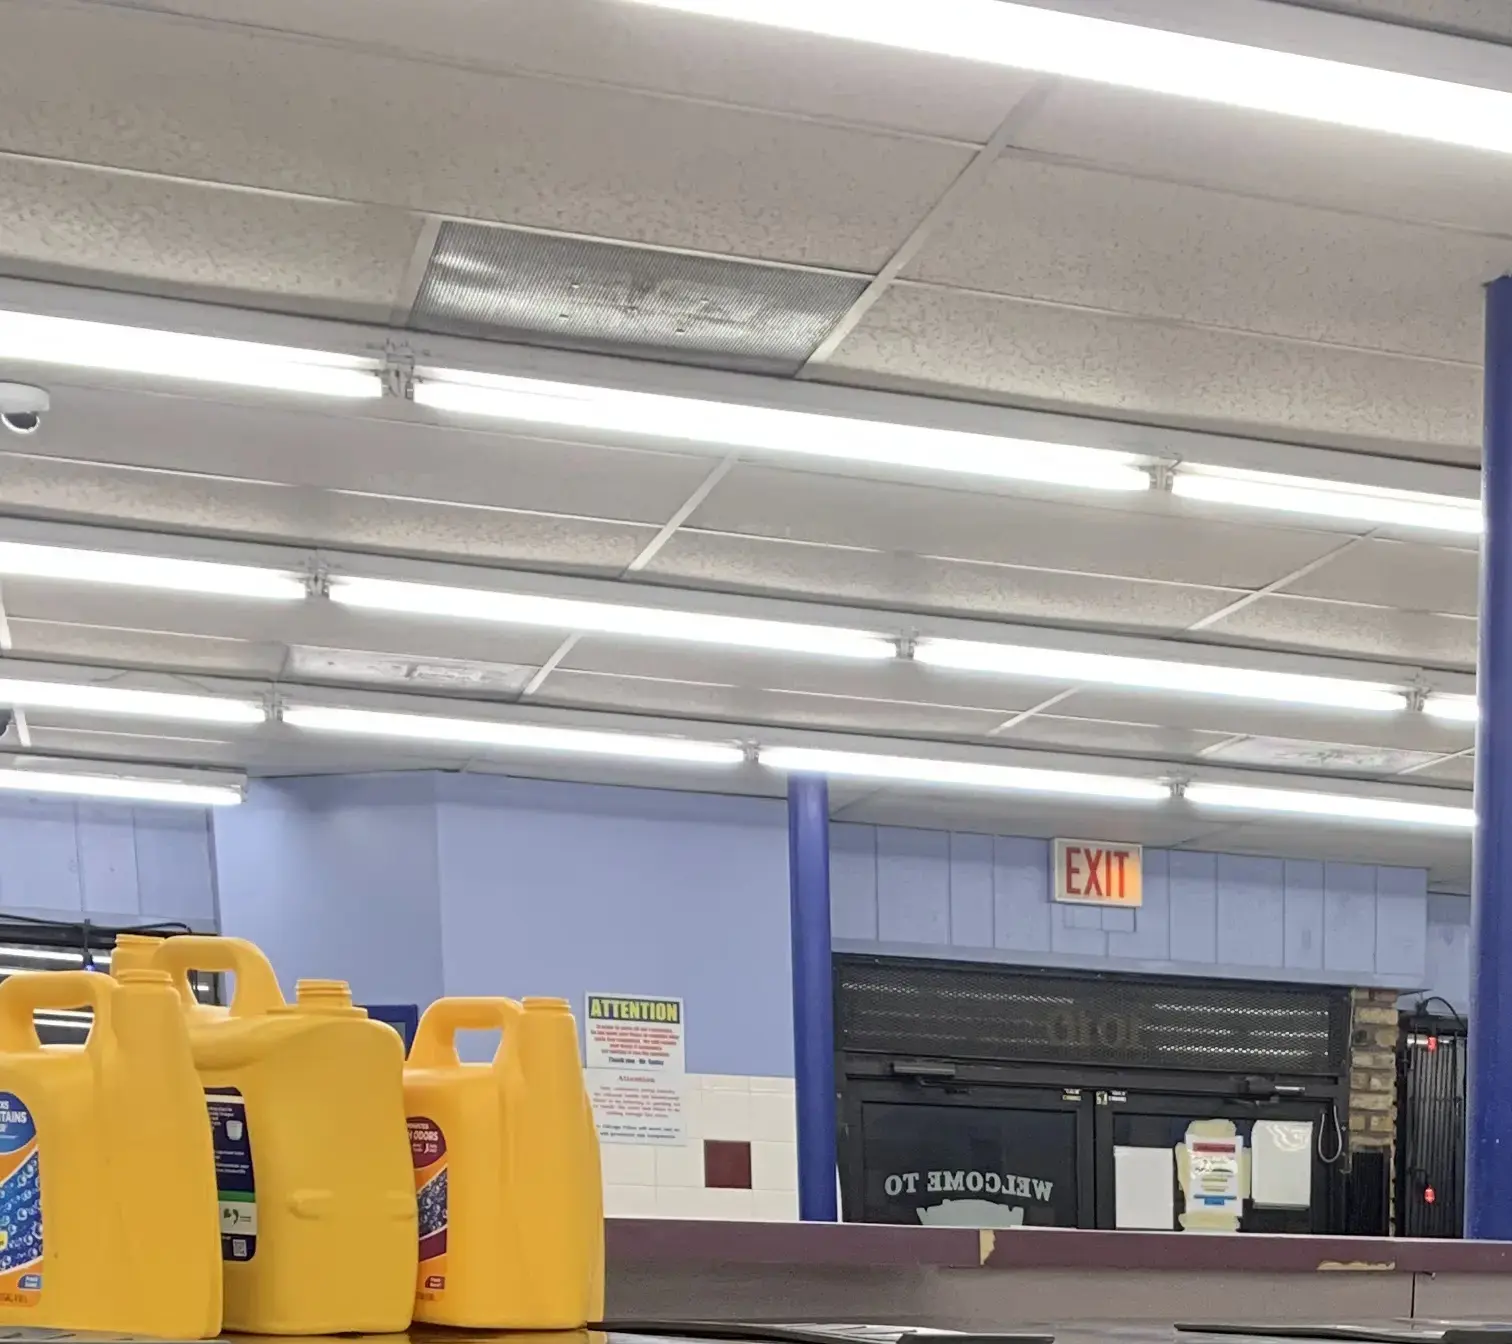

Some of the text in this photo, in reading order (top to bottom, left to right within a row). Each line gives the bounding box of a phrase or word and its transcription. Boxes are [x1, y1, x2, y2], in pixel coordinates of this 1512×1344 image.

[1066, 847, 1129, 898] EXIT
[591, 999, 678, 1022] ATTENTION
[0, 1111, 27, 1123] TAINS
